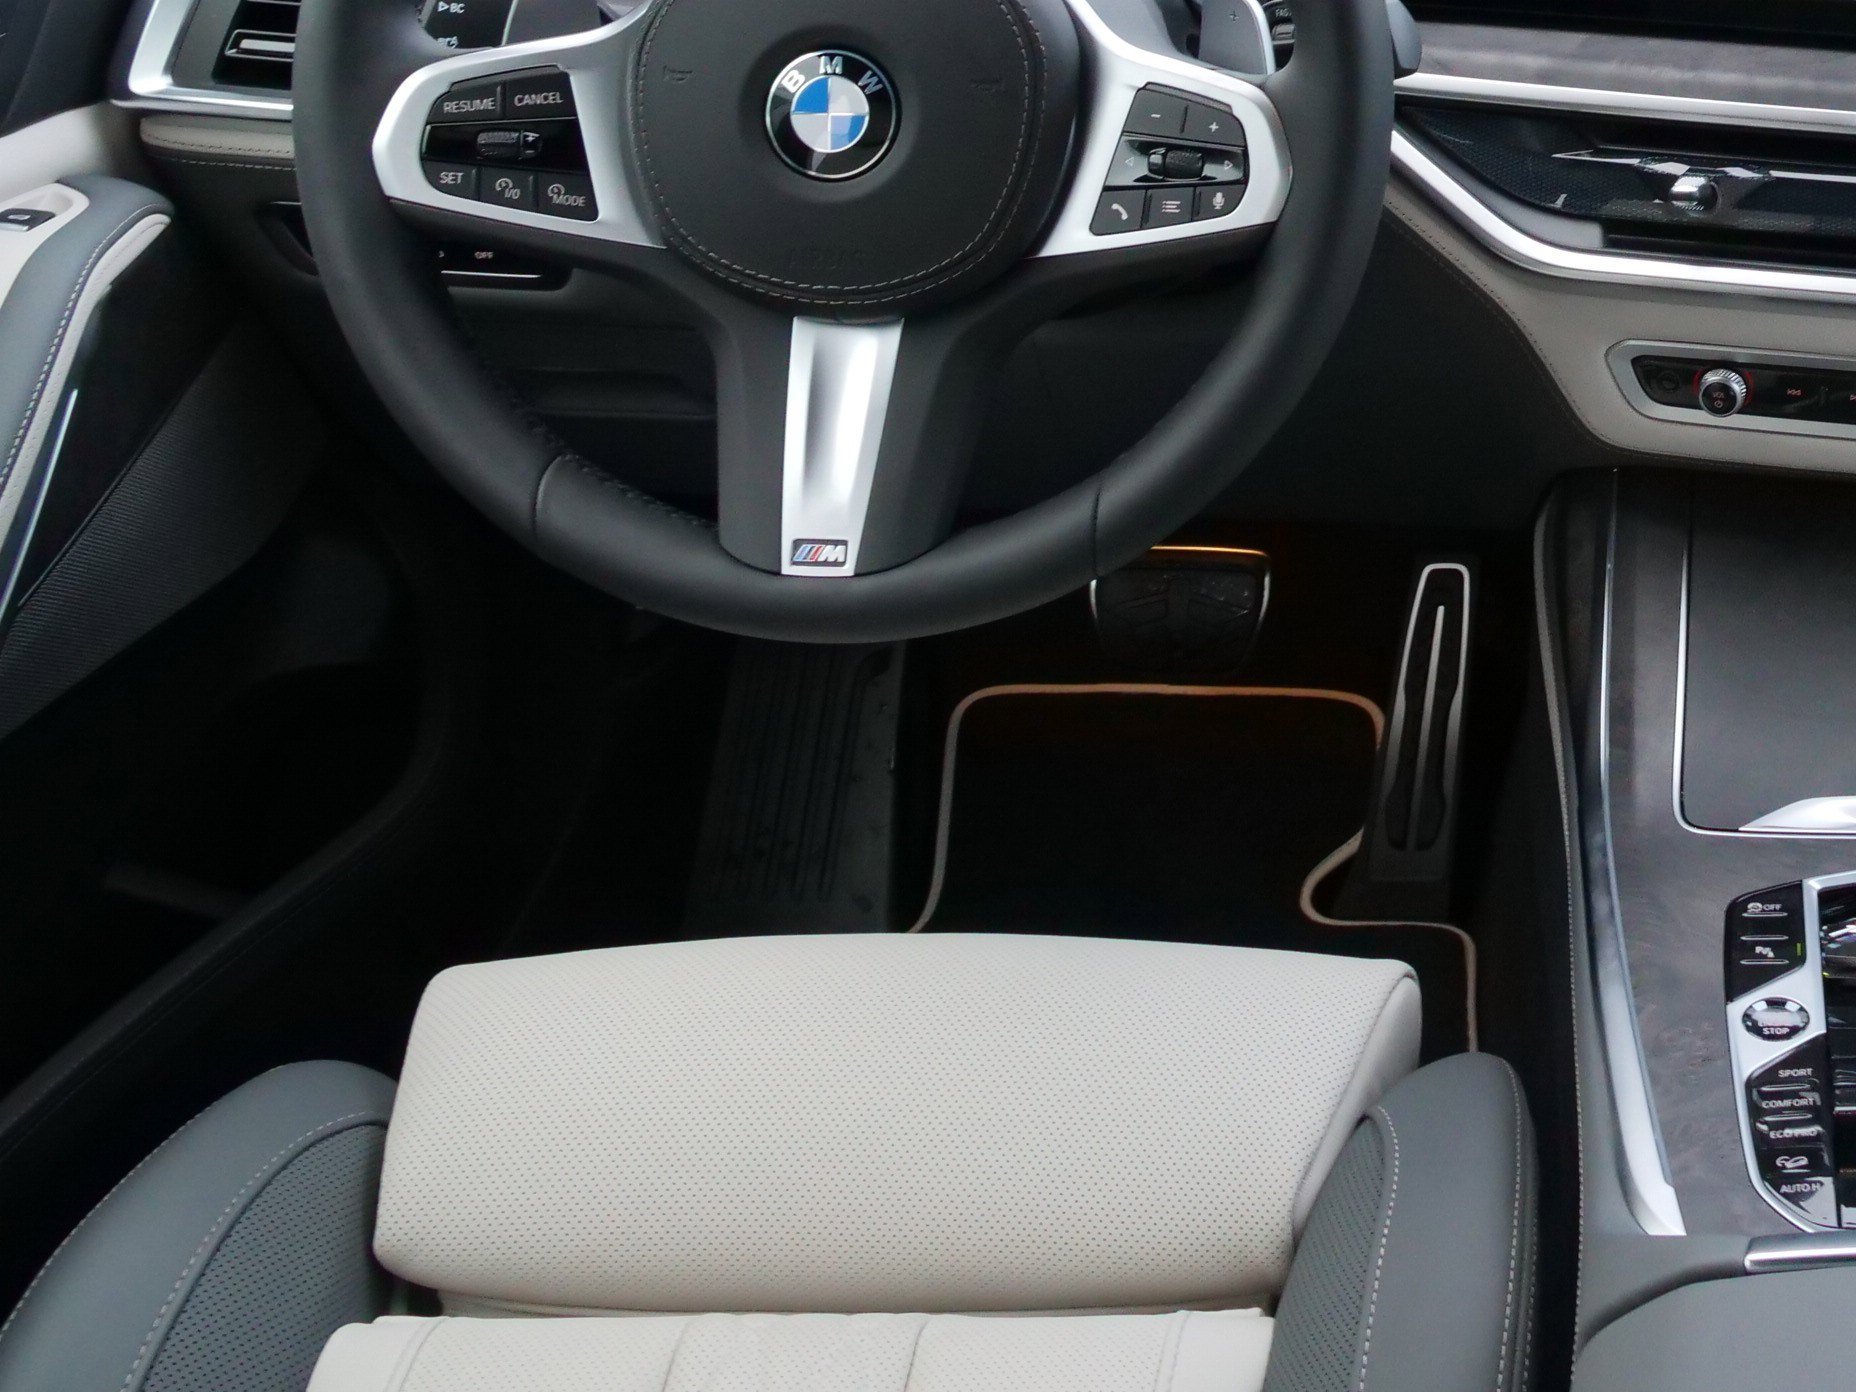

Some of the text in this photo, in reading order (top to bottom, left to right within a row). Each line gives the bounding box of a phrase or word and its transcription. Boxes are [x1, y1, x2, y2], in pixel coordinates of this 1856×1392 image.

[449, 2, 465, 14] BC
[781, 56, 883, 95] BMW
[443, 92, 564, 113] RESUME CANCEL
[439, 172, 464, 184] SET
[552, 195, 586, 207] MODE
[475, 251, 494, 259] OFF
[1778, 1068, 1813, 1077] SPORT
[1762, 1098, 1815, 1108] COMFORT
[1769, 1128, 1792, 1139] ECO
[1780, 1182, 1821, 1193] AUTO H
